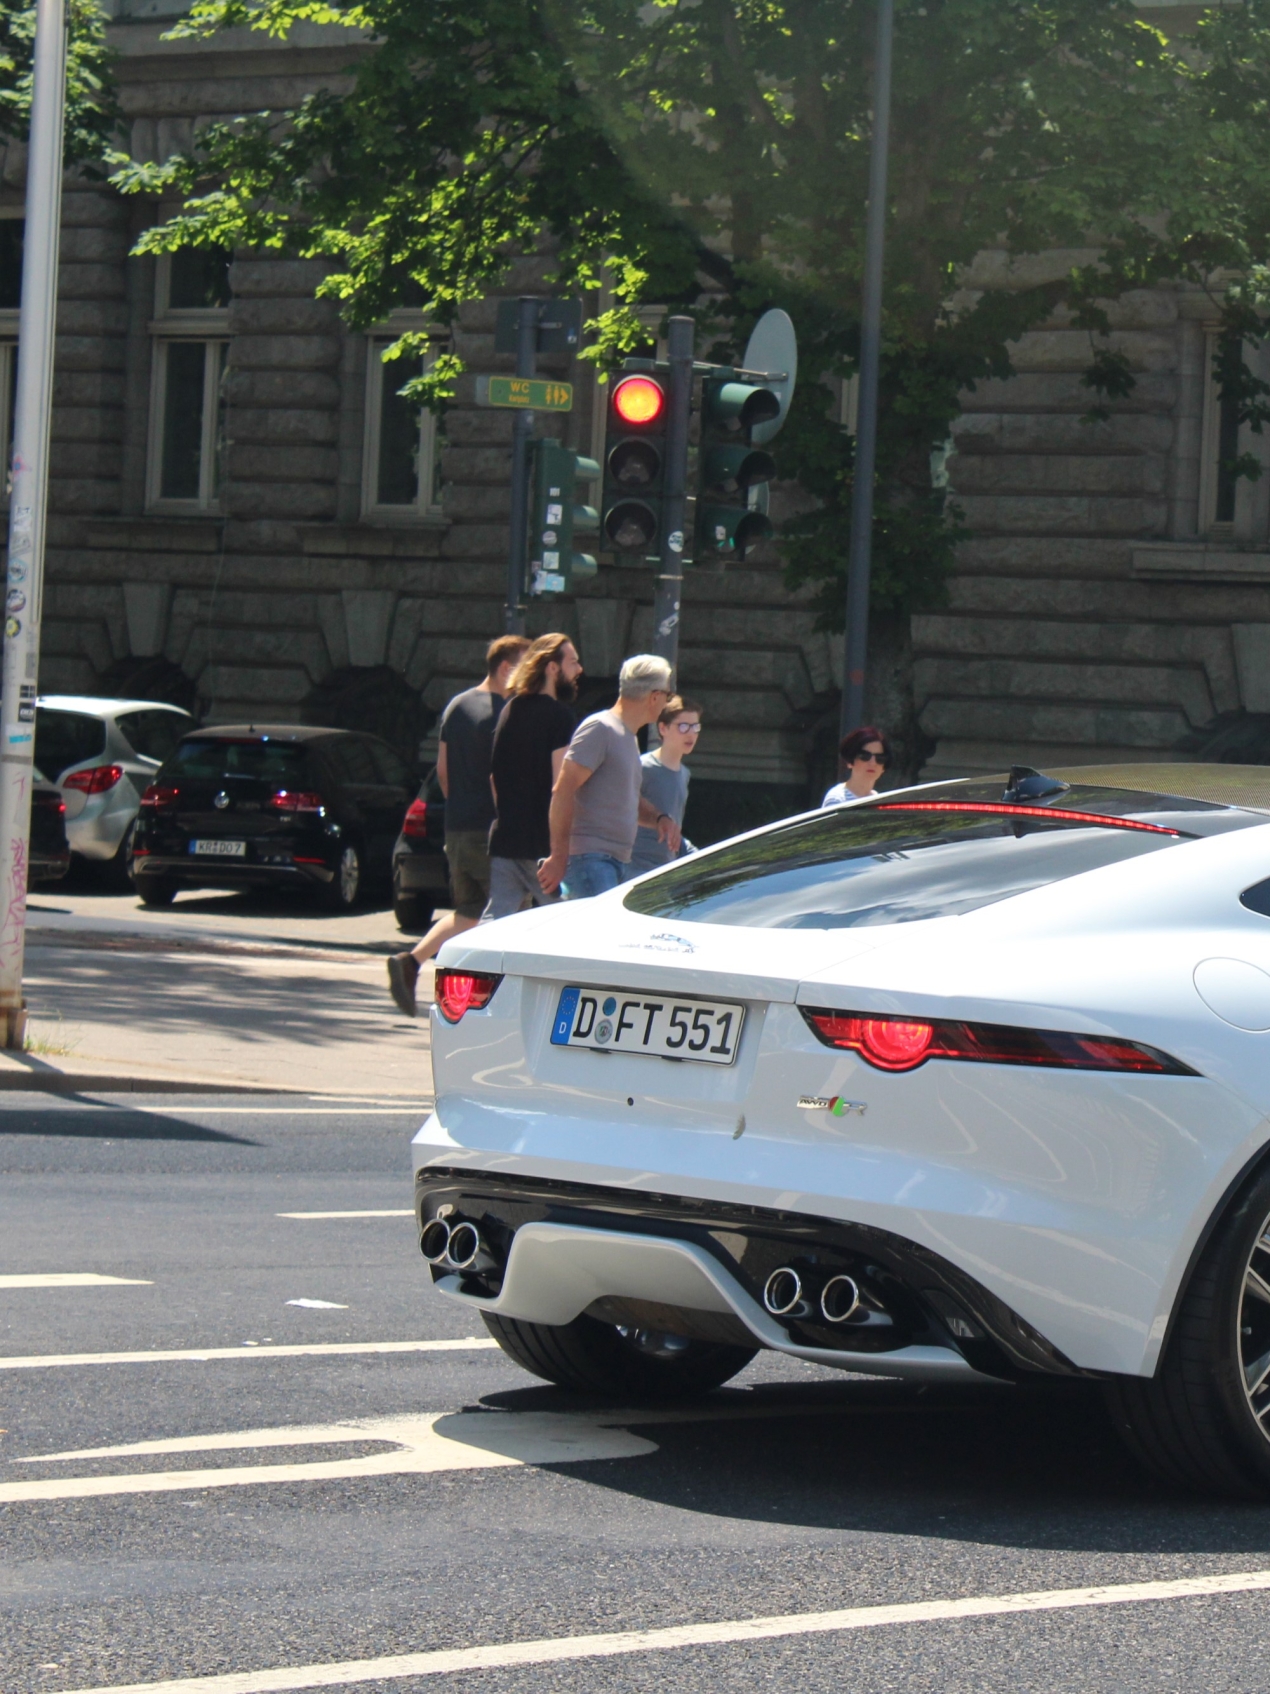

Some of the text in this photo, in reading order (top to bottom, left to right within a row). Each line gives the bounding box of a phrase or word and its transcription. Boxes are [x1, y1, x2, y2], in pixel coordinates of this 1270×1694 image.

[511, 381, 530, 393] WC
[199, 841, 212, 853] KR
[235, 843, 242, 854] 7
[558, 1022, 566, 1034] D
[572, 996, 735, 1055] D FT 551
[800, 1099, 827, 1107] AWD
